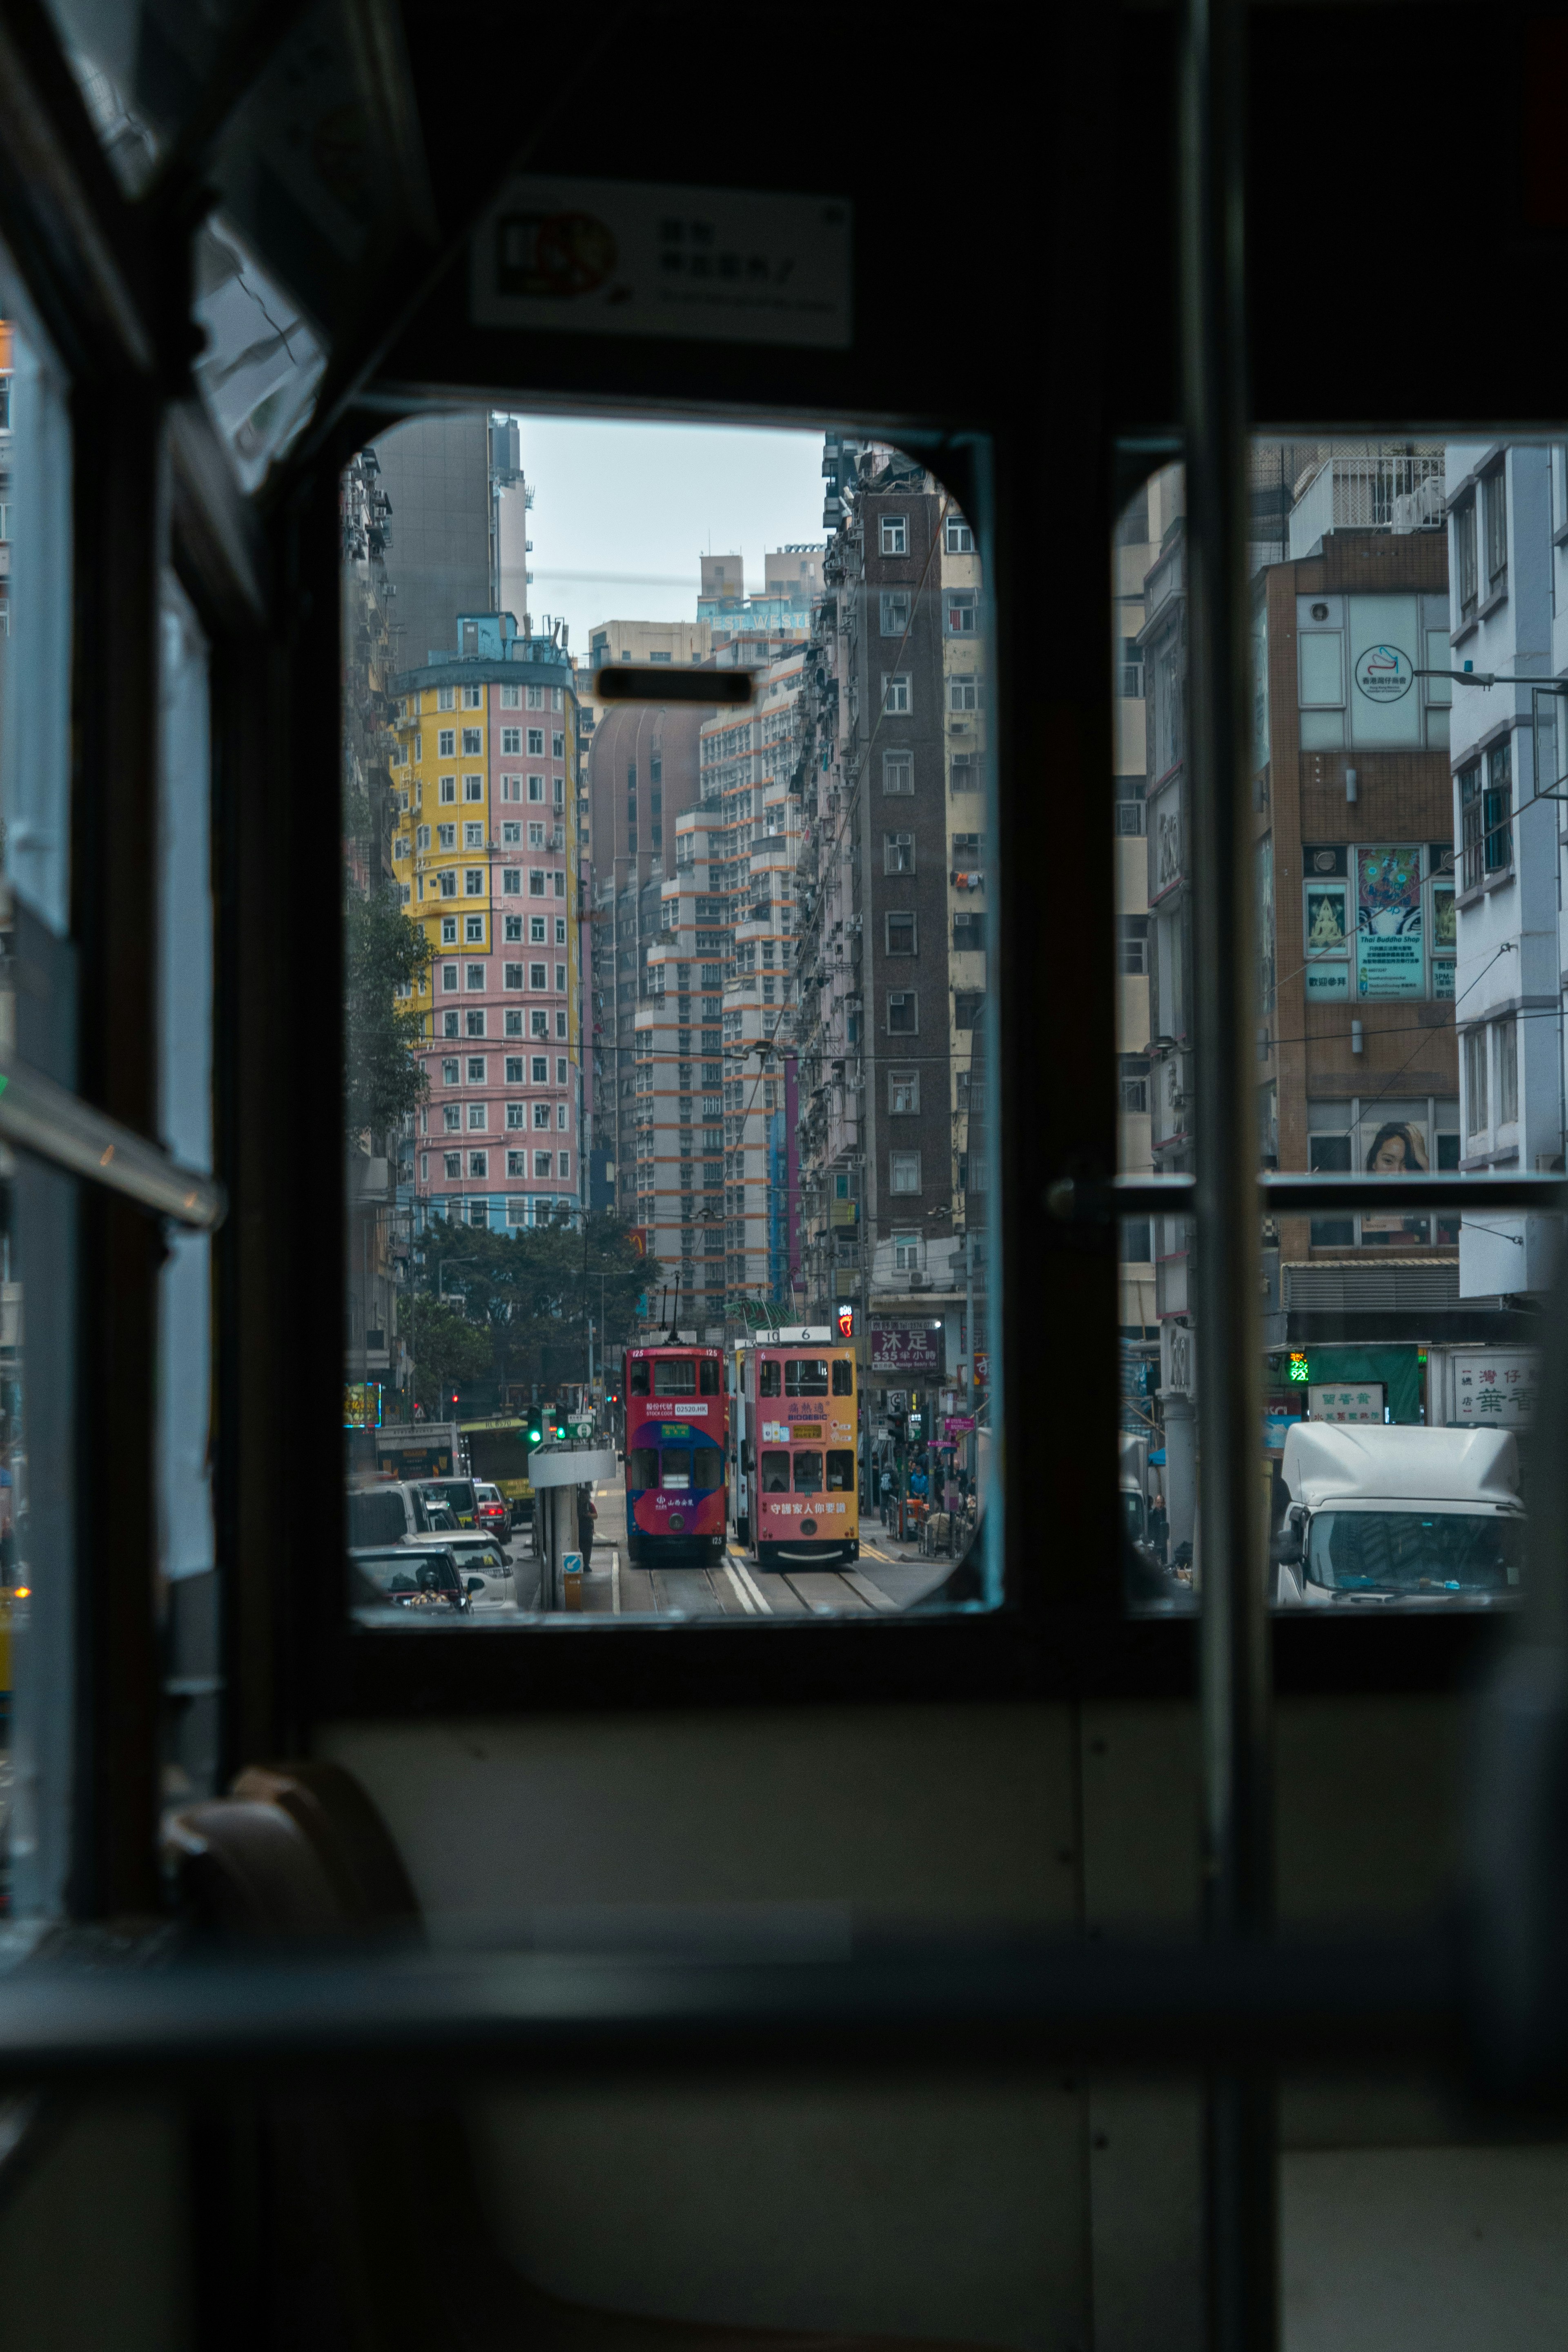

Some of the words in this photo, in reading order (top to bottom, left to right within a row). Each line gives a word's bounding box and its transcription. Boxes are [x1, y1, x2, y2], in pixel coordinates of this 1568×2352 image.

[1309, 977, 1346, 987] 歡迎參拜
[768, 1332, 779, 1342] 10
[802, 1328, 810, 1340] 6
[882, 1331, 928, 1351] 沐足
[633, 1349, 644, 1357] 125
[706, 1349, 717, 1357] 125
[874, 1351, 898, 1361] $35
[900, 1350, 936, 1360] 半小時
[771, 1503, 846, 1515] 守護家人你要識
[713, 1537, 722, 1545] 125
[851, 1542, 855, 1550] 6
